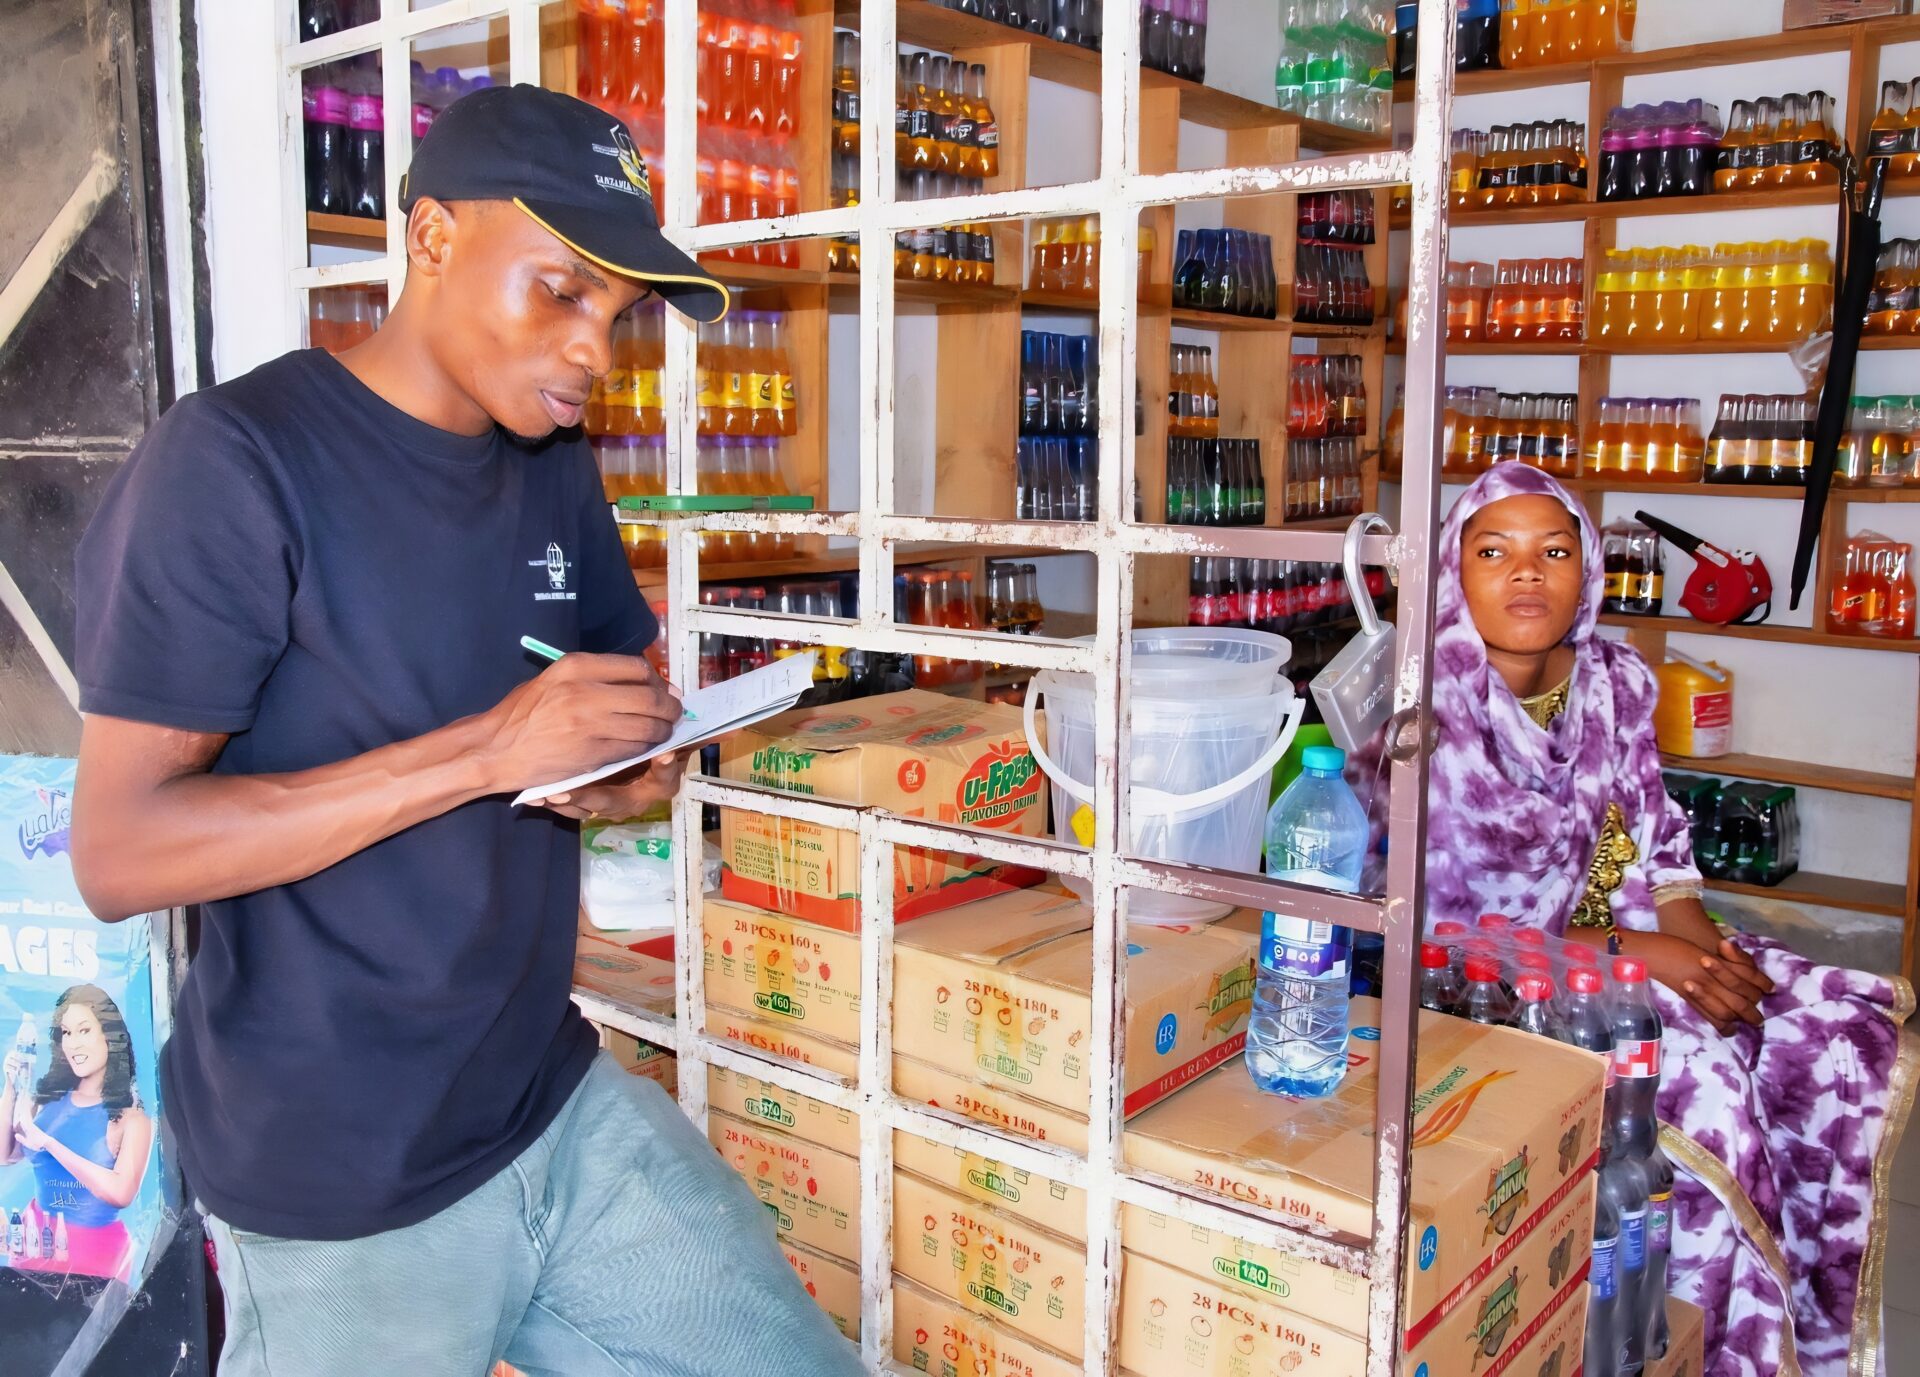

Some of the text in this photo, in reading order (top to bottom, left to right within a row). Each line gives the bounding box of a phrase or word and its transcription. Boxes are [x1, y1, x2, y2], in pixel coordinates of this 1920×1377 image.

[964, 750, 1038, 808] U-FRESH
[961, 802, 1011, 824] FLAVORED
[734, 920, 747, 933] 28
[750, 923, 777, 941] PCS
[790, 933, 811, 949] 160
[813, 942, 821, 954] g
[772, 994, 789, 1010] 160
[964, 979, 980, 993] 28
[1023, 998, 1047, 1014] 180
[1050, 1006, 1059, 1020] g
[726, 1026, 740, 1039] 28
[743, 1030, 768, 1048] PCS
[780, 1042, 800, 1058] 160
[803, 1051, 811, 1063] g
[1158, 1024, 1174, 1046] HR
[725, 1129, 738, 1142] 28
[955, 1094, 970, 1108] 28
[972, 1100, 1000, 1121] PCS
[1013, 1116, 1035, 1132] 180
[1037, 1127, 1046, 1141] g
[1194, 1169, 1214, 1186] 28
[1220, 1177, 1258, 1201] PCS
[1280, 1196, 1311, 1217] 180
[1315, 1208, 1327, 1225] g
[951, 1213, 966, 1226] 28
[1217, 1259, 1237, 1276] Net
[1270, 1280, 1286, 1295] ml
[1191, 1292, 1212, 1310] 28
[1217, 1302, 1255, 1326] PCS
[1276, 1324, 1306, 1347] 180
[1310, 1342, 1321, 1357] g
